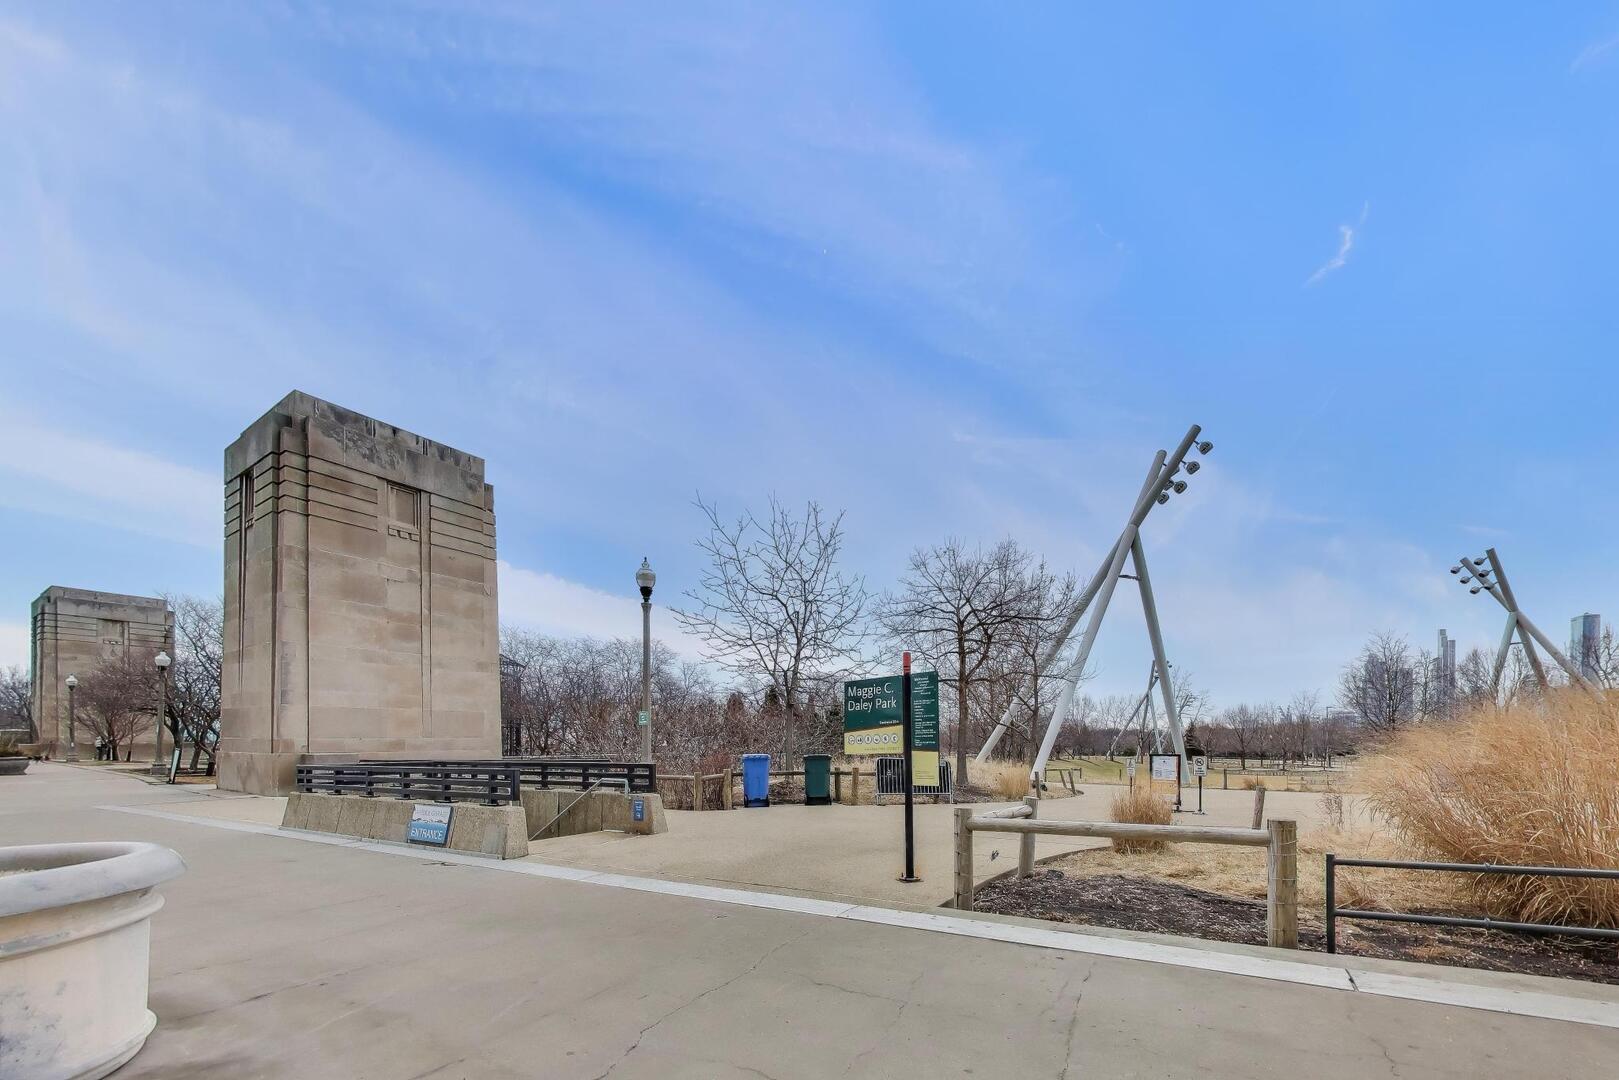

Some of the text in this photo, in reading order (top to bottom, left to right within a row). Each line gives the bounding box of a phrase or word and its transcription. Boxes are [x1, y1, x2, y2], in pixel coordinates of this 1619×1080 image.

[848, 682, 894, 699] Maggie C.
[848, 696, 897, 712] Daley Park
[411, 828, 443, 840] ENTRANCE
